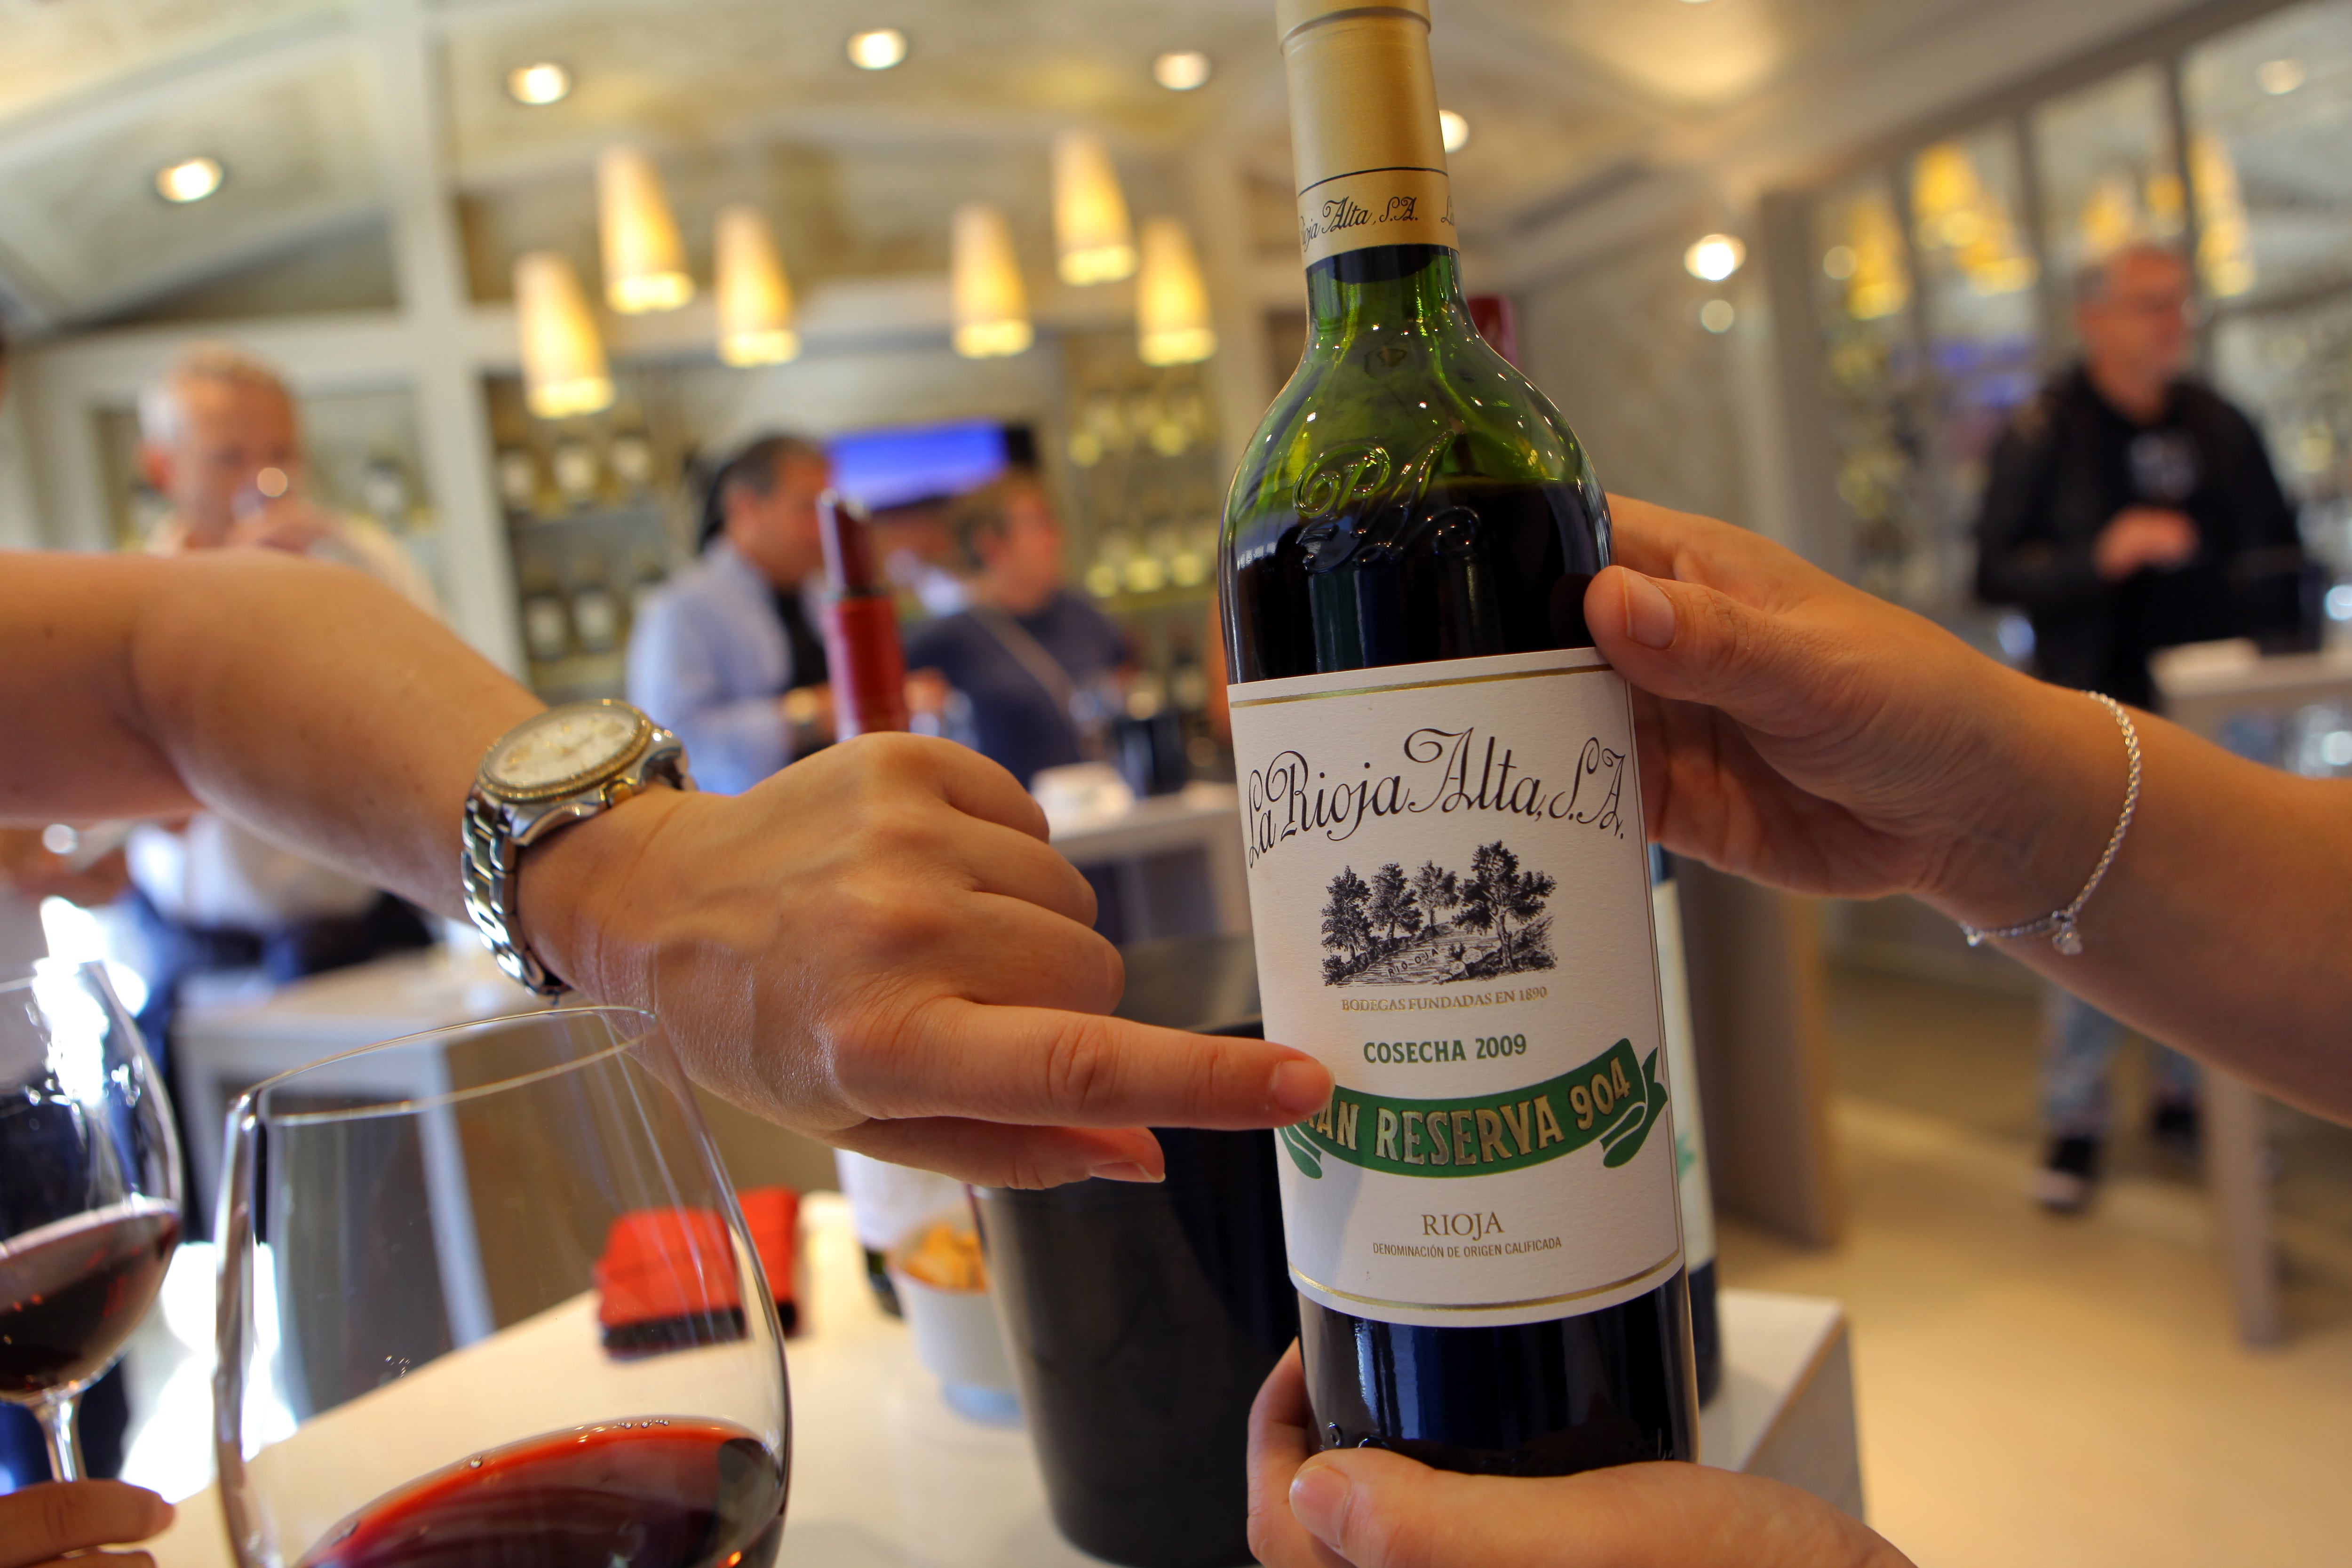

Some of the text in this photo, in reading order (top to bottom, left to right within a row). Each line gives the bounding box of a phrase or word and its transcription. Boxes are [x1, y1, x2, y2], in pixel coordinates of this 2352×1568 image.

[1321, 196, 1376, 234] Alta,
[1379, 196, 1419, 222] S.A.
[1248, 726, 1627, 868] La Rioja Alta, S.A.
[1342, 987, 1548, 1012] BODEGAS FUNDADAS EN 1890
[1363, 1034, 1526, 1064] COSECHA 2009
[1305, 1056, 1631, 1166] AN RESERVA 904
[1421, 1211, 1505, 1241] RIOJA
[1373, 1236, 1562, 1258] DENOMINACIÓN DE ORIGEN CALIFICADA
